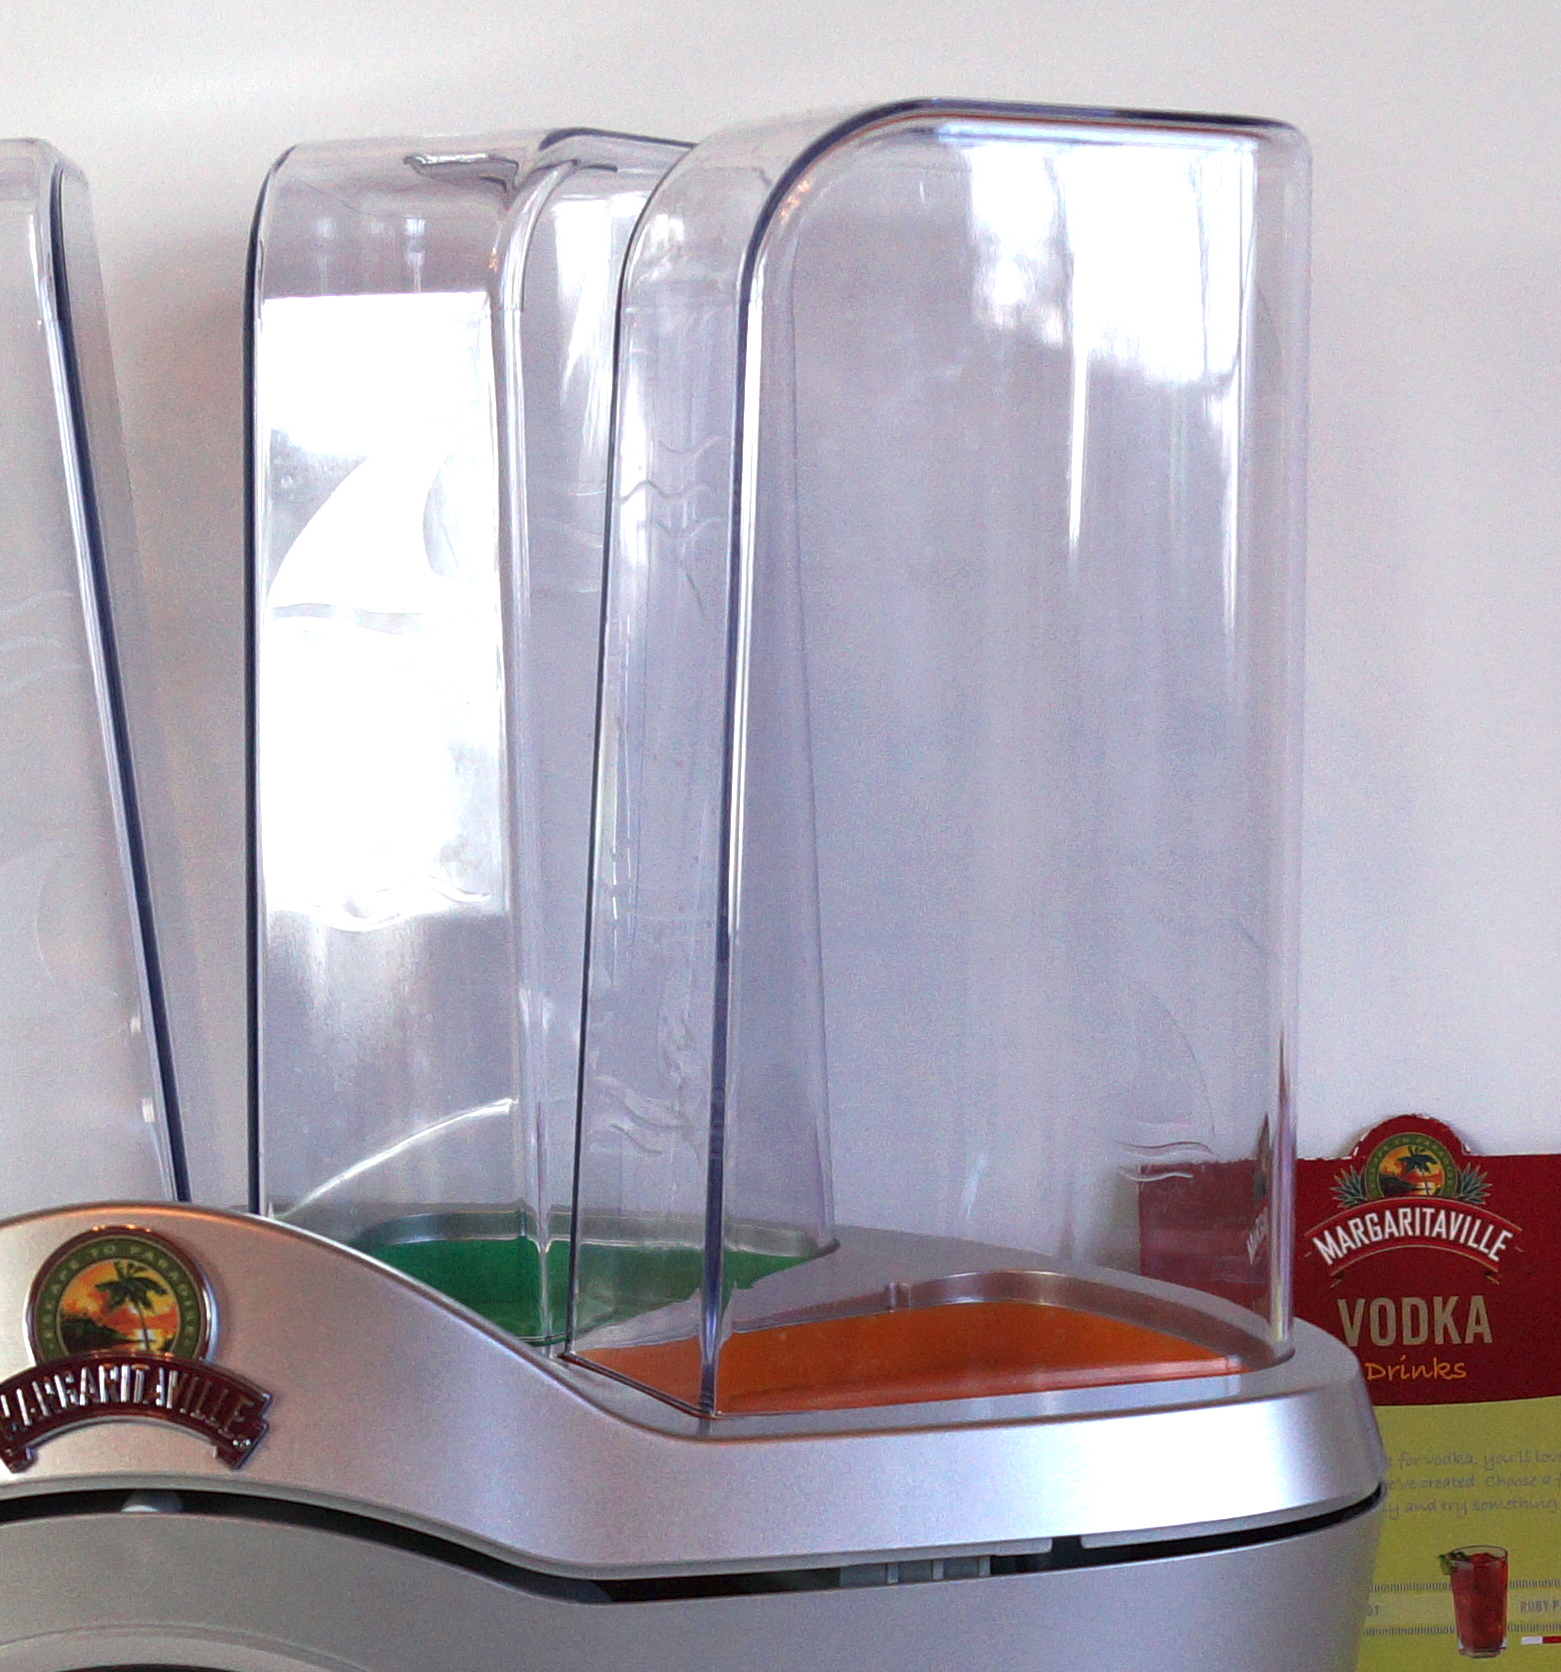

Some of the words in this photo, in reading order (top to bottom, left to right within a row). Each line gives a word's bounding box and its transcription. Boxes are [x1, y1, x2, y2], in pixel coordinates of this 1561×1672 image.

[1312, 1206, 1514, 1265] MARGARITAVILLE
[1338, 1294, 1493, 1347] VODKA
[1364, 1354, 1466, 1382] Drinks
[1520, 1601, 1548, 1613] RUBY
